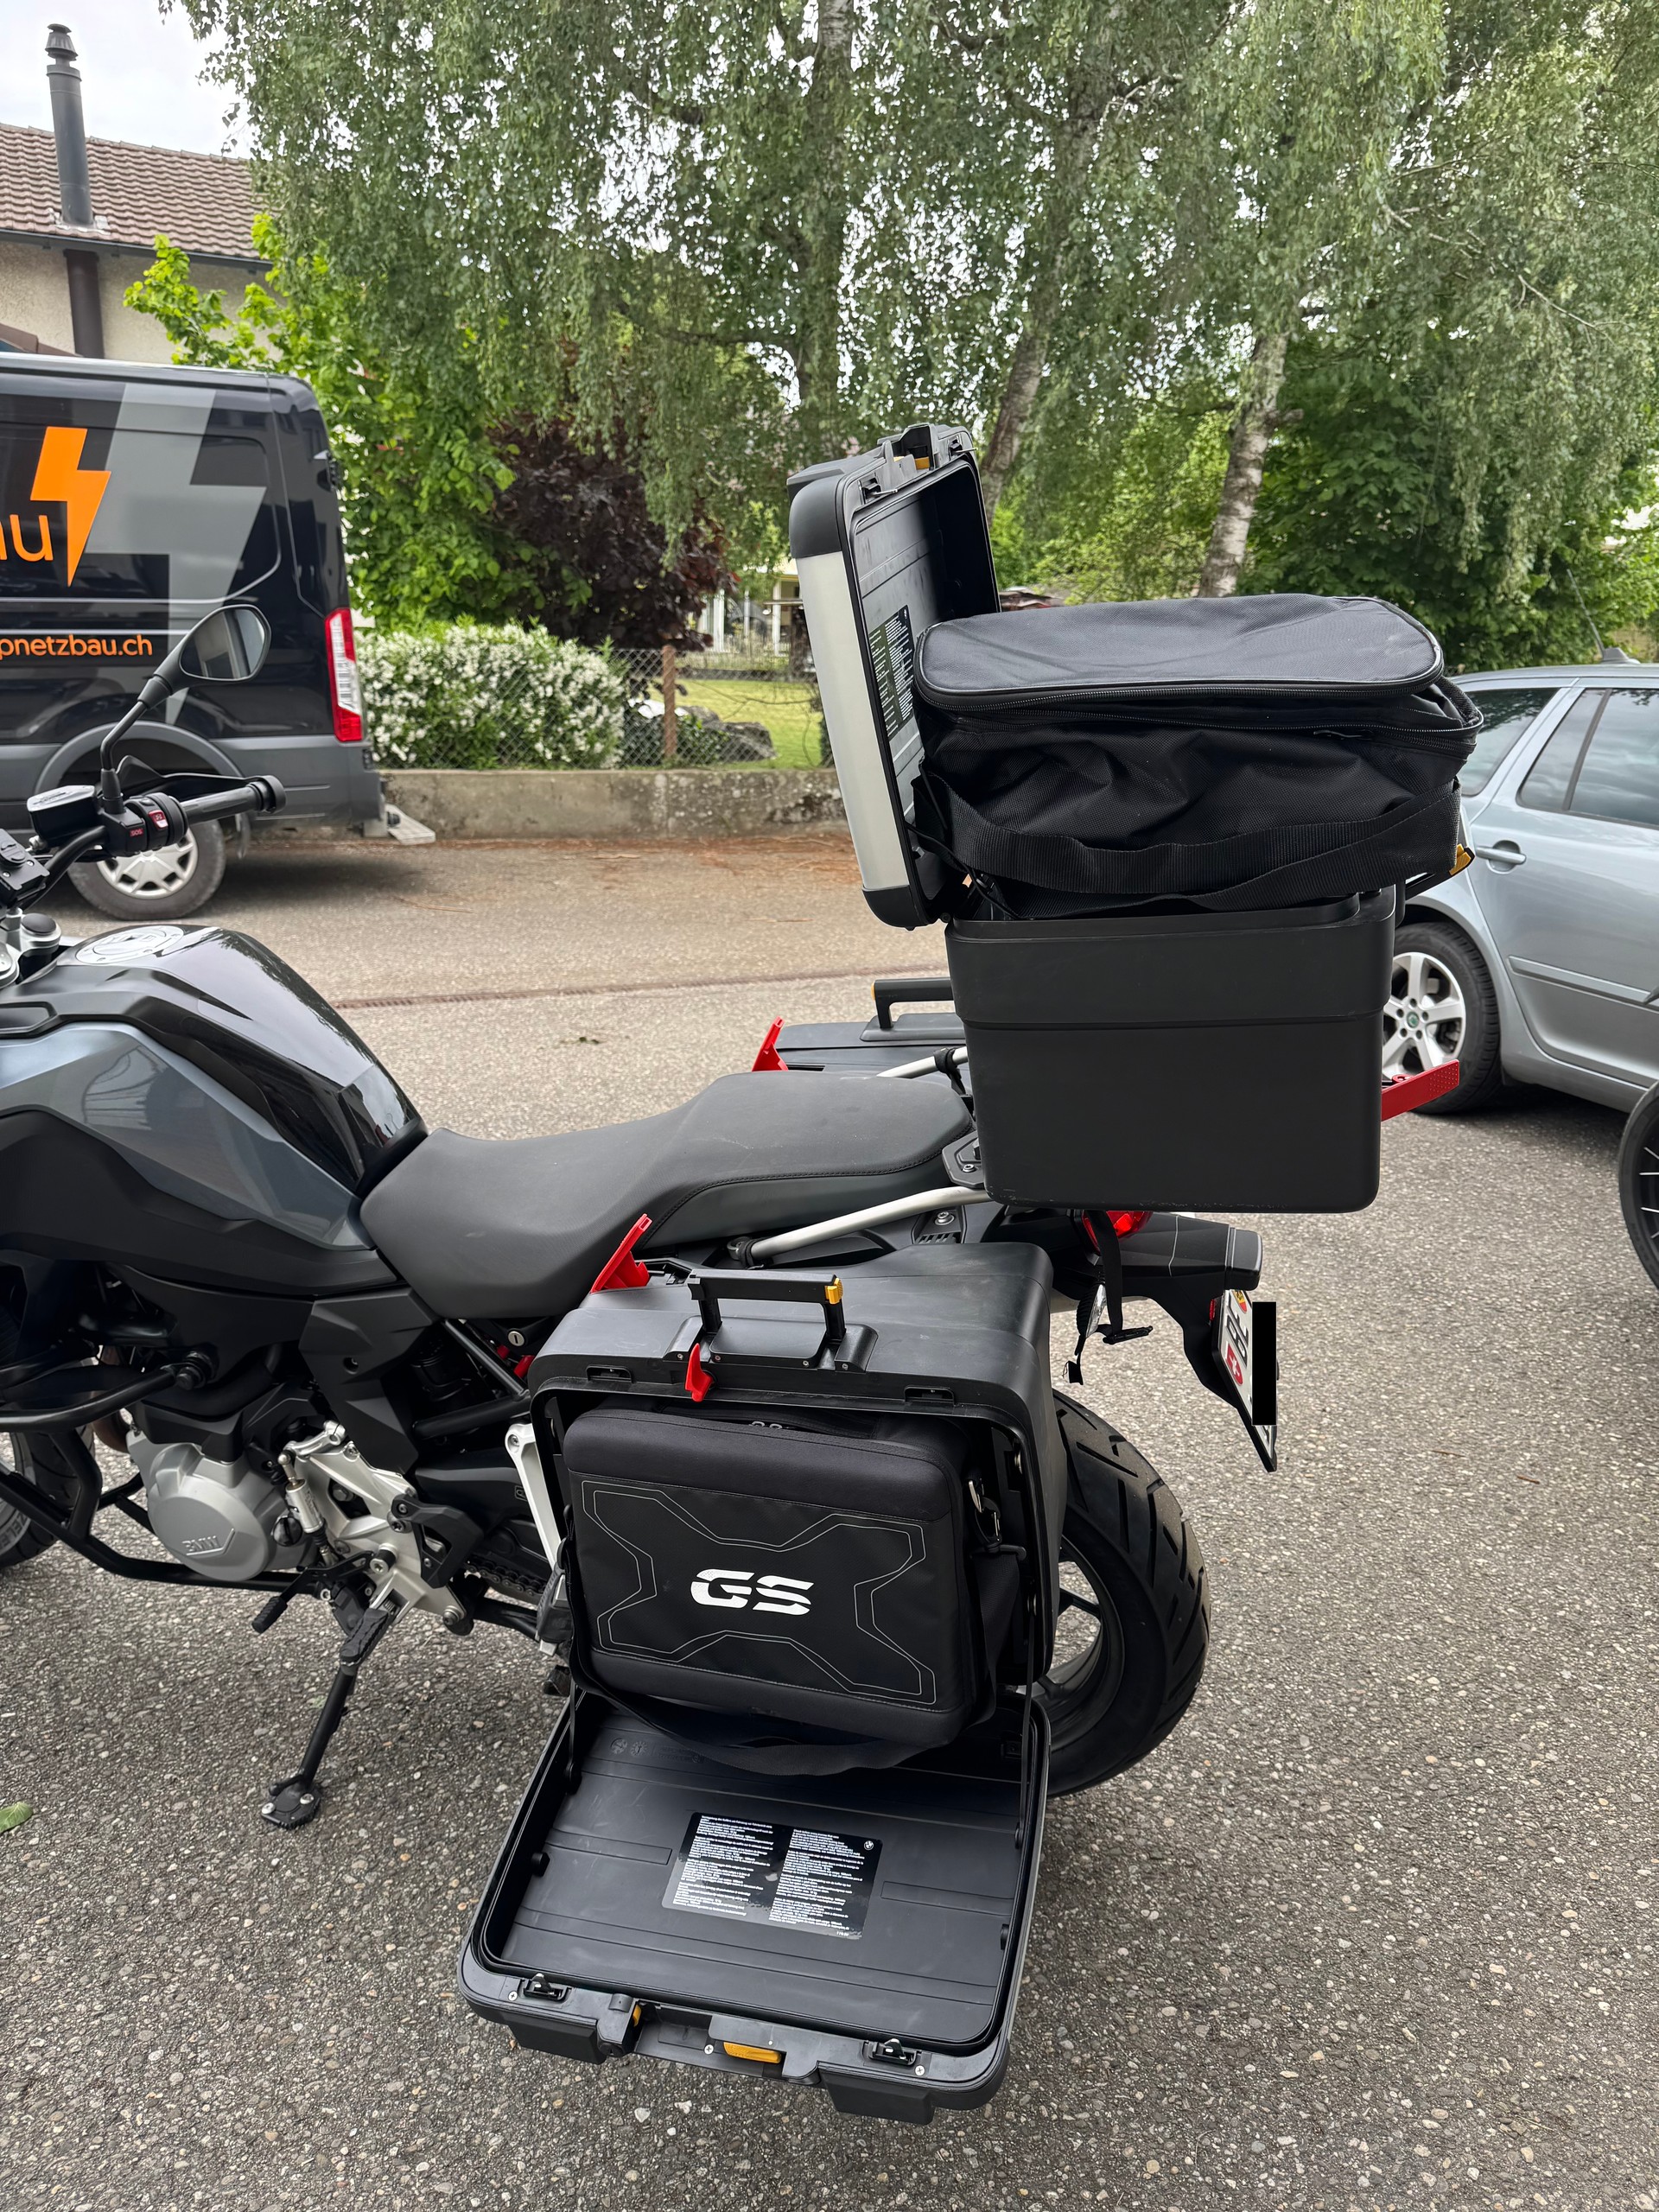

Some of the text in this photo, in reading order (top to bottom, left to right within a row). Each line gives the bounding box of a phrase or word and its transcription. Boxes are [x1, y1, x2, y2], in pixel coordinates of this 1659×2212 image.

[0, 514, 54, 561] u
[0, 634, 153, 661] pnetzbau.ch
[0, 1512, 28, 1549] ZELE
[181, 1535, 219, 1553] BMW
[690, 1568, 814, 1616] GS
